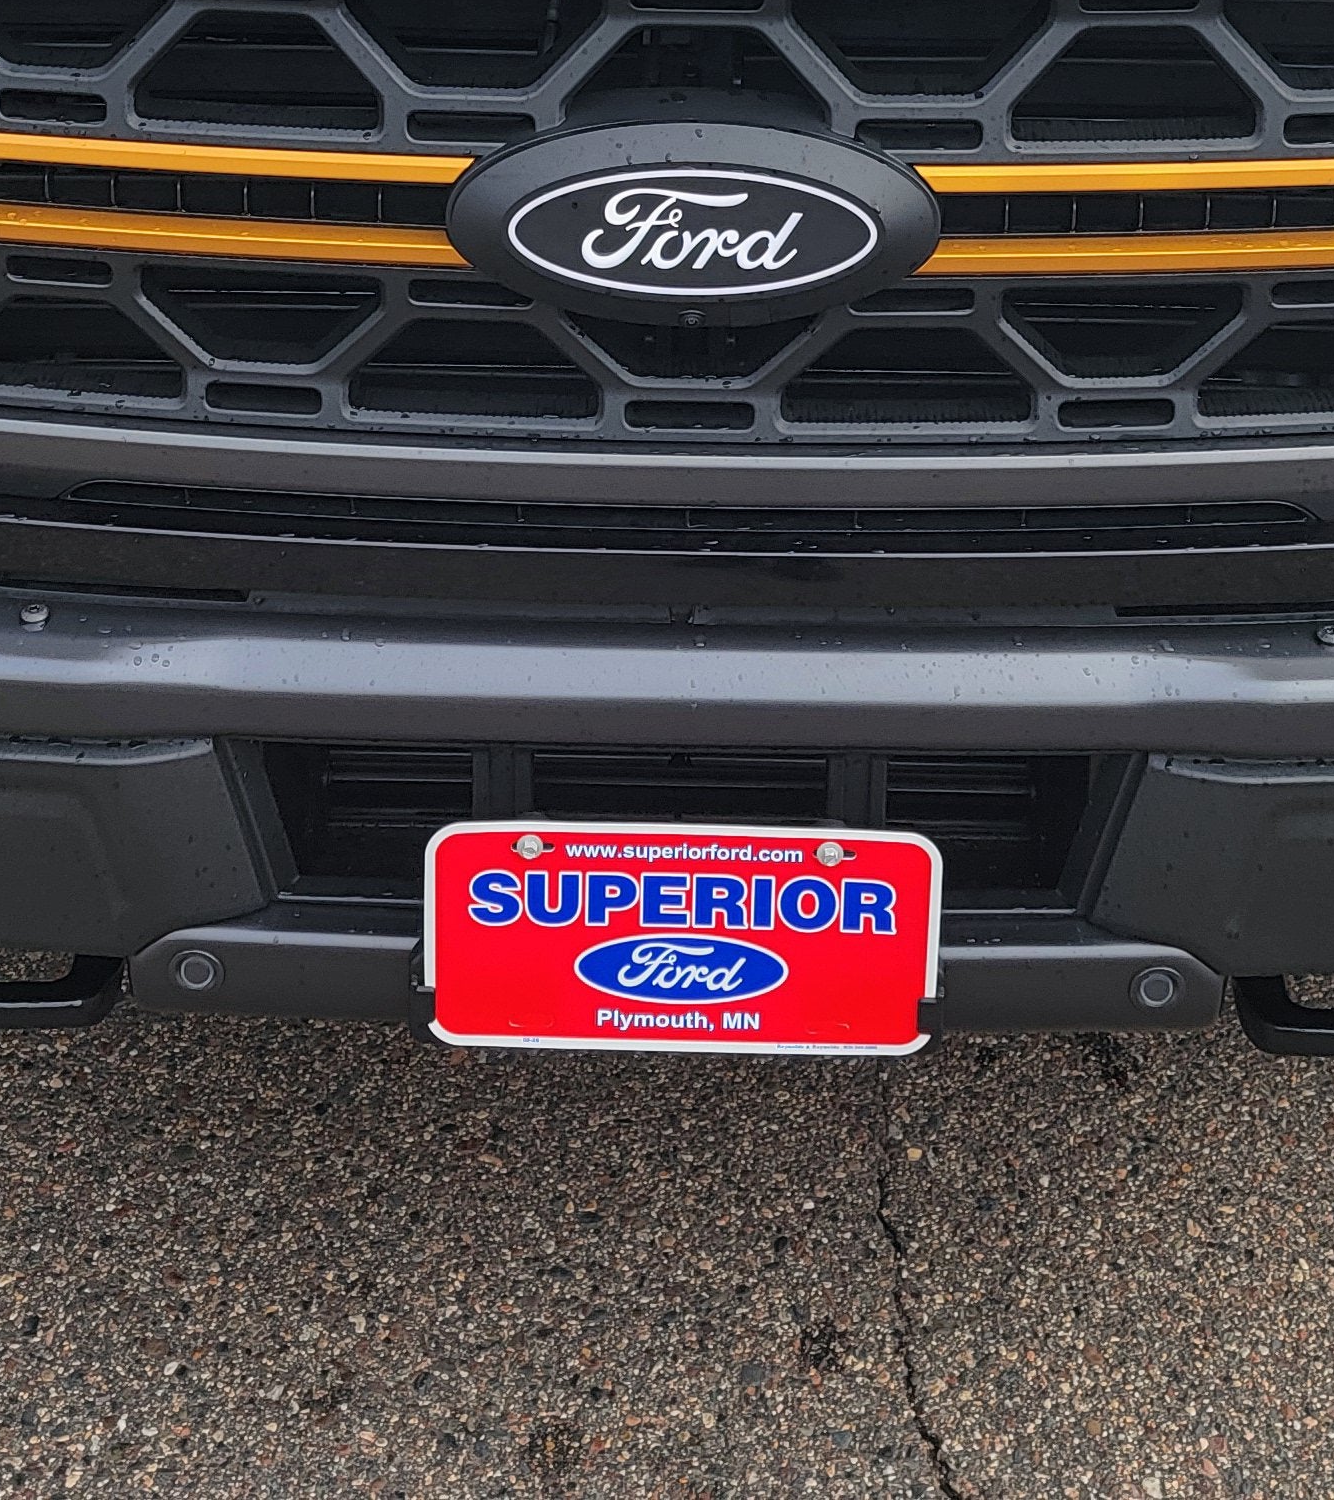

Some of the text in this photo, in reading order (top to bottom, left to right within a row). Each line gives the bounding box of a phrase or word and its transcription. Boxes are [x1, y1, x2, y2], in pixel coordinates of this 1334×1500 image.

[581, 188, 803, 270] Ford
[565, 841, 804, 864] www.superiorford.com
[468, 869, 897, 935] SUPERIOR
[617, 941, 744, 992] Ford
[597, 1009, 760, 1031] Plymouth, MN
